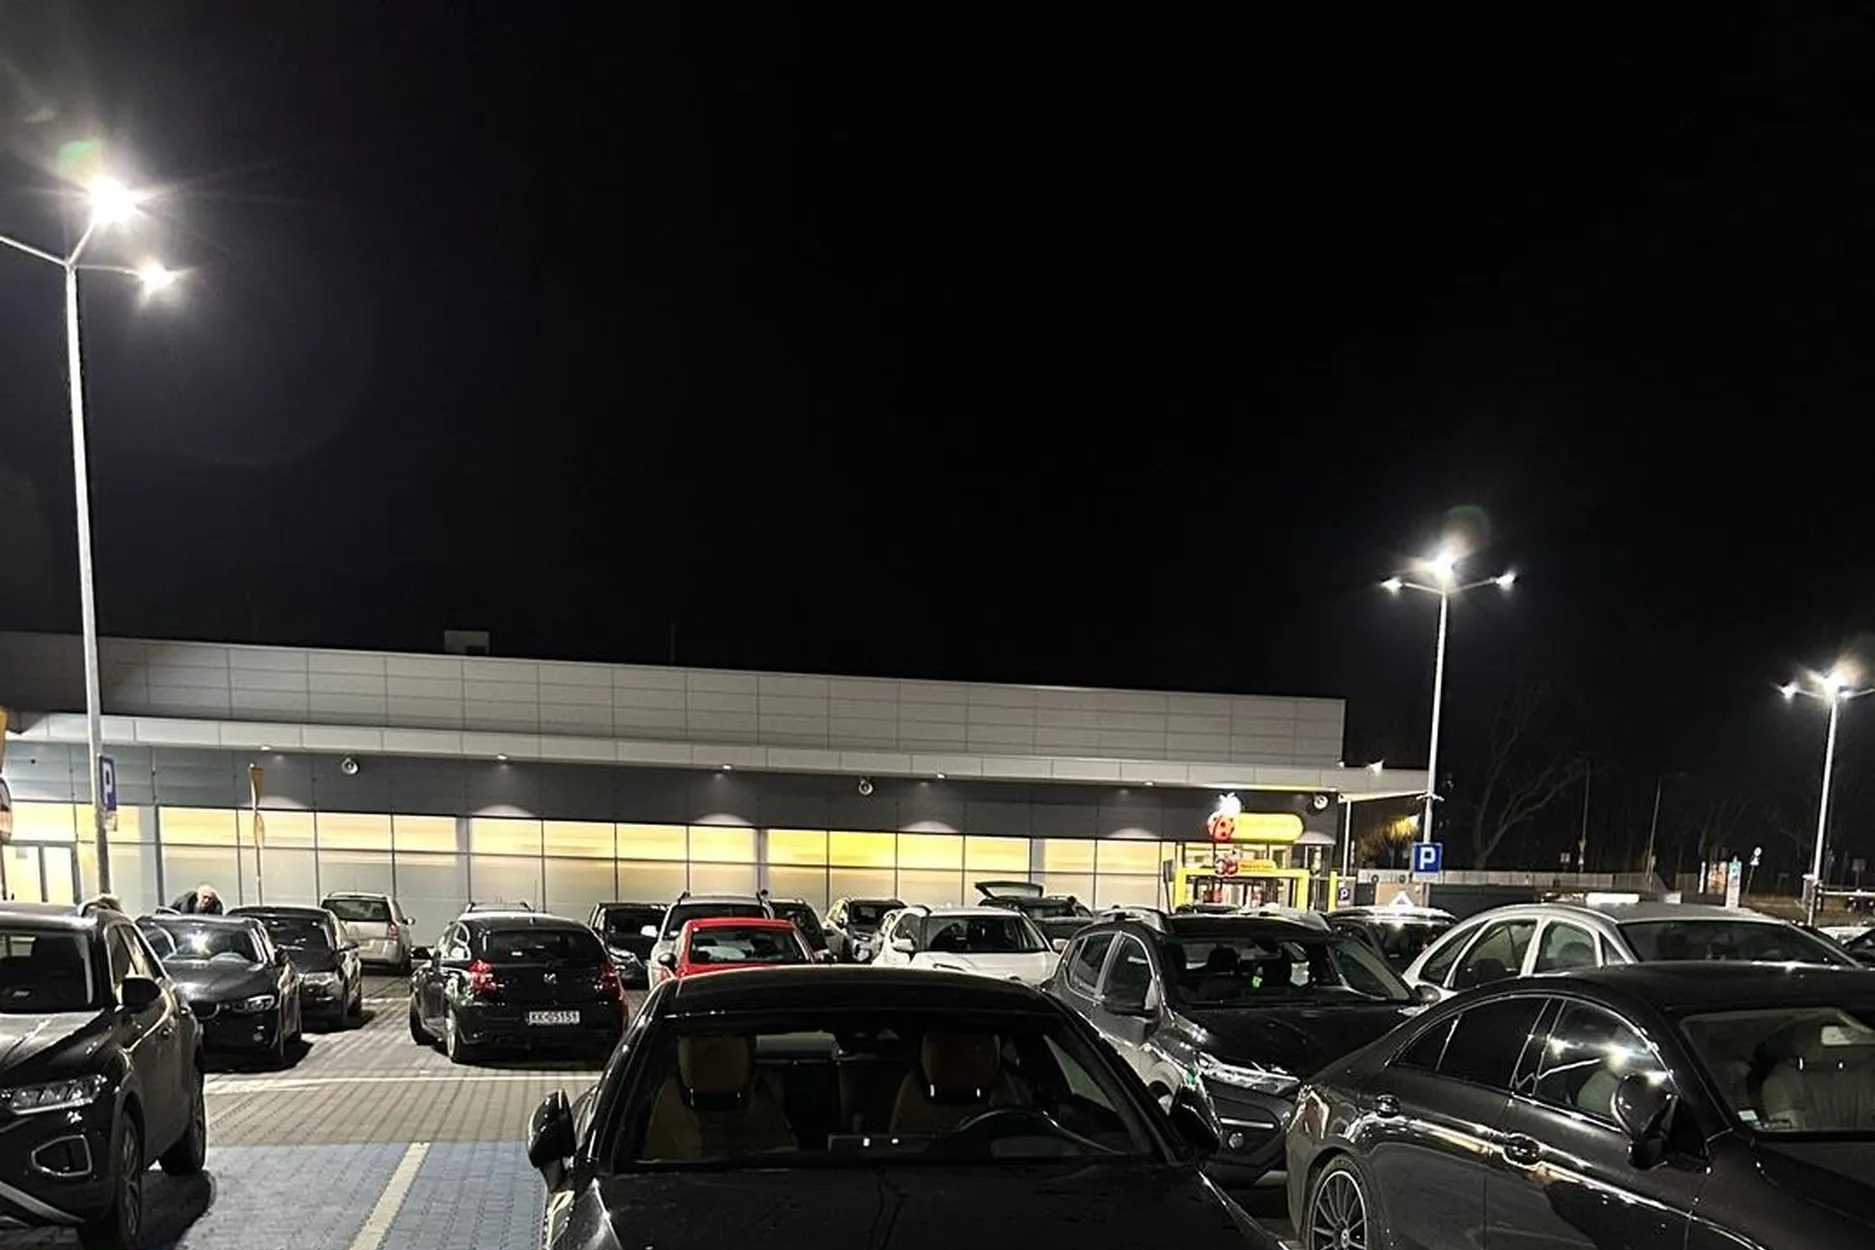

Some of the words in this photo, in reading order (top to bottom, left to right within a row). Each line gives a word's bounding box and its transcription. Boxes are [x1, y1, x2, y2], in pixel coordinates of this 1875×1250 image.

[103, 763, 113, 804] P
[1420, 847, 1436, 870] P
[1340, 888, 1349, 900] P
